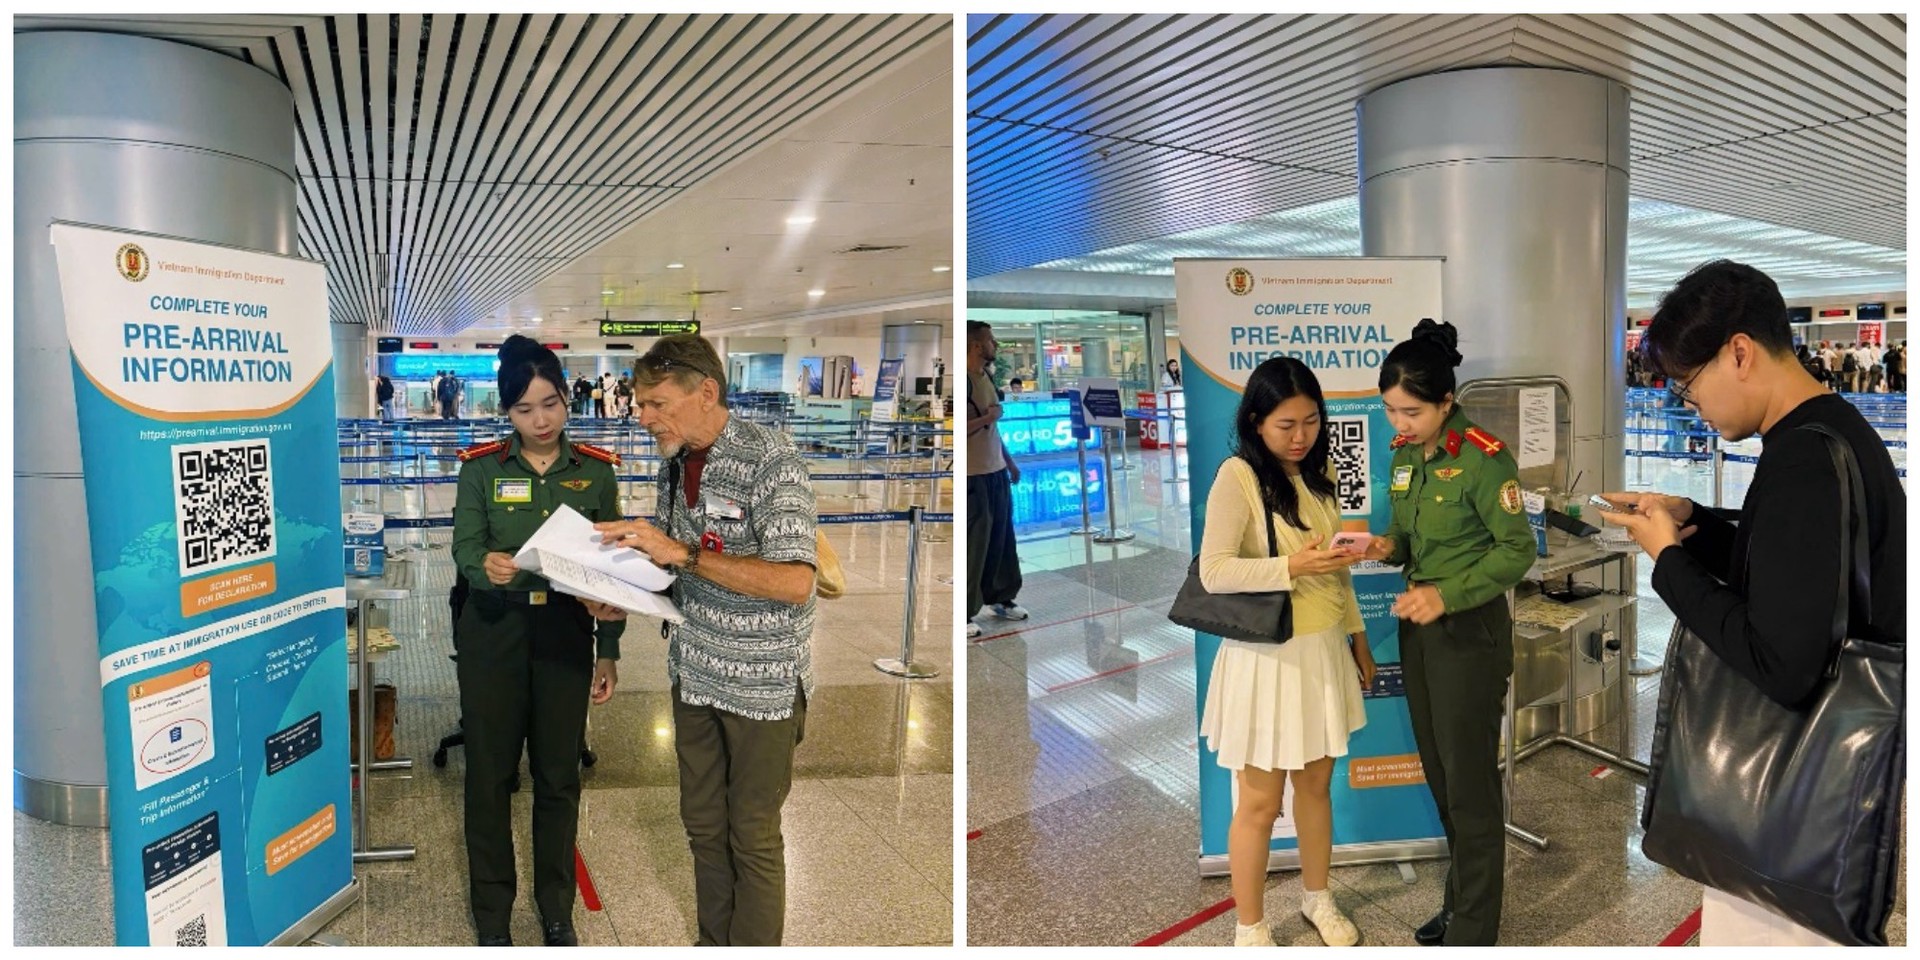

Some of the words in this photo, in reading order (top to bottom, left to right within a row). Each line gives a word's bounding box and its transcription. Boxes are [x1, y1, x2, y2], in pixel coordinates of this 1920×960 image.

[157, 260, 193, 273] Vietnam
[195, 266, 243, 279] Immigration
[244, 271, 285, 285] Department
[1261, 277, 1295, 285] Vietnam
[1296, 277, 1344, 286] Immigration
[1347, 277, 1393, 286] Department
[150, 295, 230, 315] COMPLETE
[234, 303, 268, 319] YOUR
[1254, 303, 1329, 315] COMPLETE
[1334, 303, 1371, 315] YOUR
[123, 323, 288, 354] PRE-ARRIVAL
[1230, 324, 1394, 345] PRE-ARRIVAL
[122, 357, 292, 382] INFORMATION
[1012, 428, 1053, 443] CARD
[1140, 420, 1157, 440] 5G
[197, 595, 214, 607] FOR
[214, 580, 268, 604] DECLARATION
[209, 578, 231, 592] SCAN
[232, 573, 254, 587] HERE
[112, 657, 139, 671] SAVE
[140, 649, 166, 663] TIME
[168, 642, 181, 654] AT
[183, 623, 241, 650] IMMIGRATION
[241, 618, 258, 631] USE
[259, 613, 273, 627] QR
[303, 595, 327, 610] ENTER
[158, 782, 202, 806] Passenger
[140, 813, 158, 826] Trip
